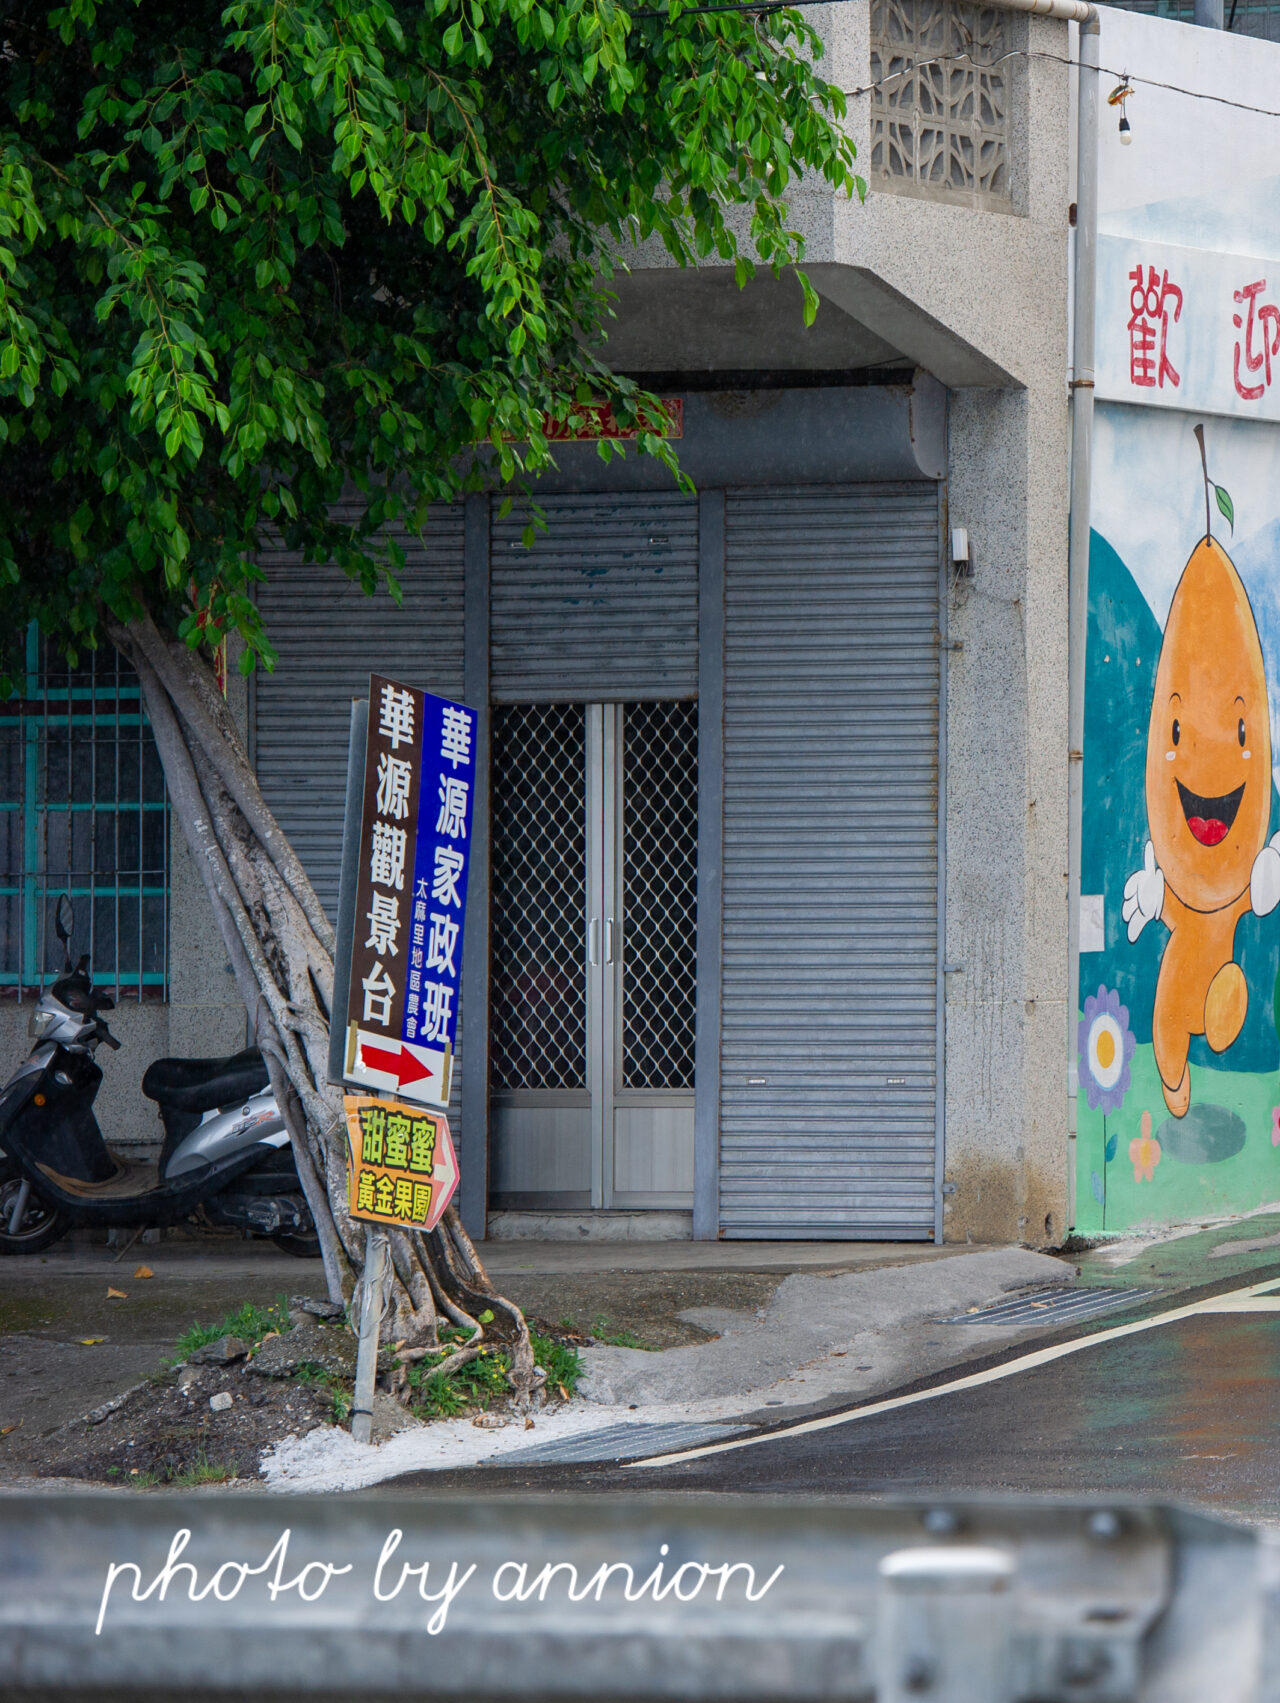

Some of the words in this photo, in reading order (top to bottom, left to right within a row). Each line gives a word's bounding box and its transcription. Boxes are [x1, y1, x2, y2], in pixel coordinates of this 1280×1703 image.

[361, 683, 416, 1028] 華源觀景台
[419, 705, 473, 1044] 華源家政班
[405, 876, 430, 1040] 太麻里地區農會
[356, 1168, 433, 1225] 黃金果園
[358, 1106, 437, 1178] 甜蜜蜜
